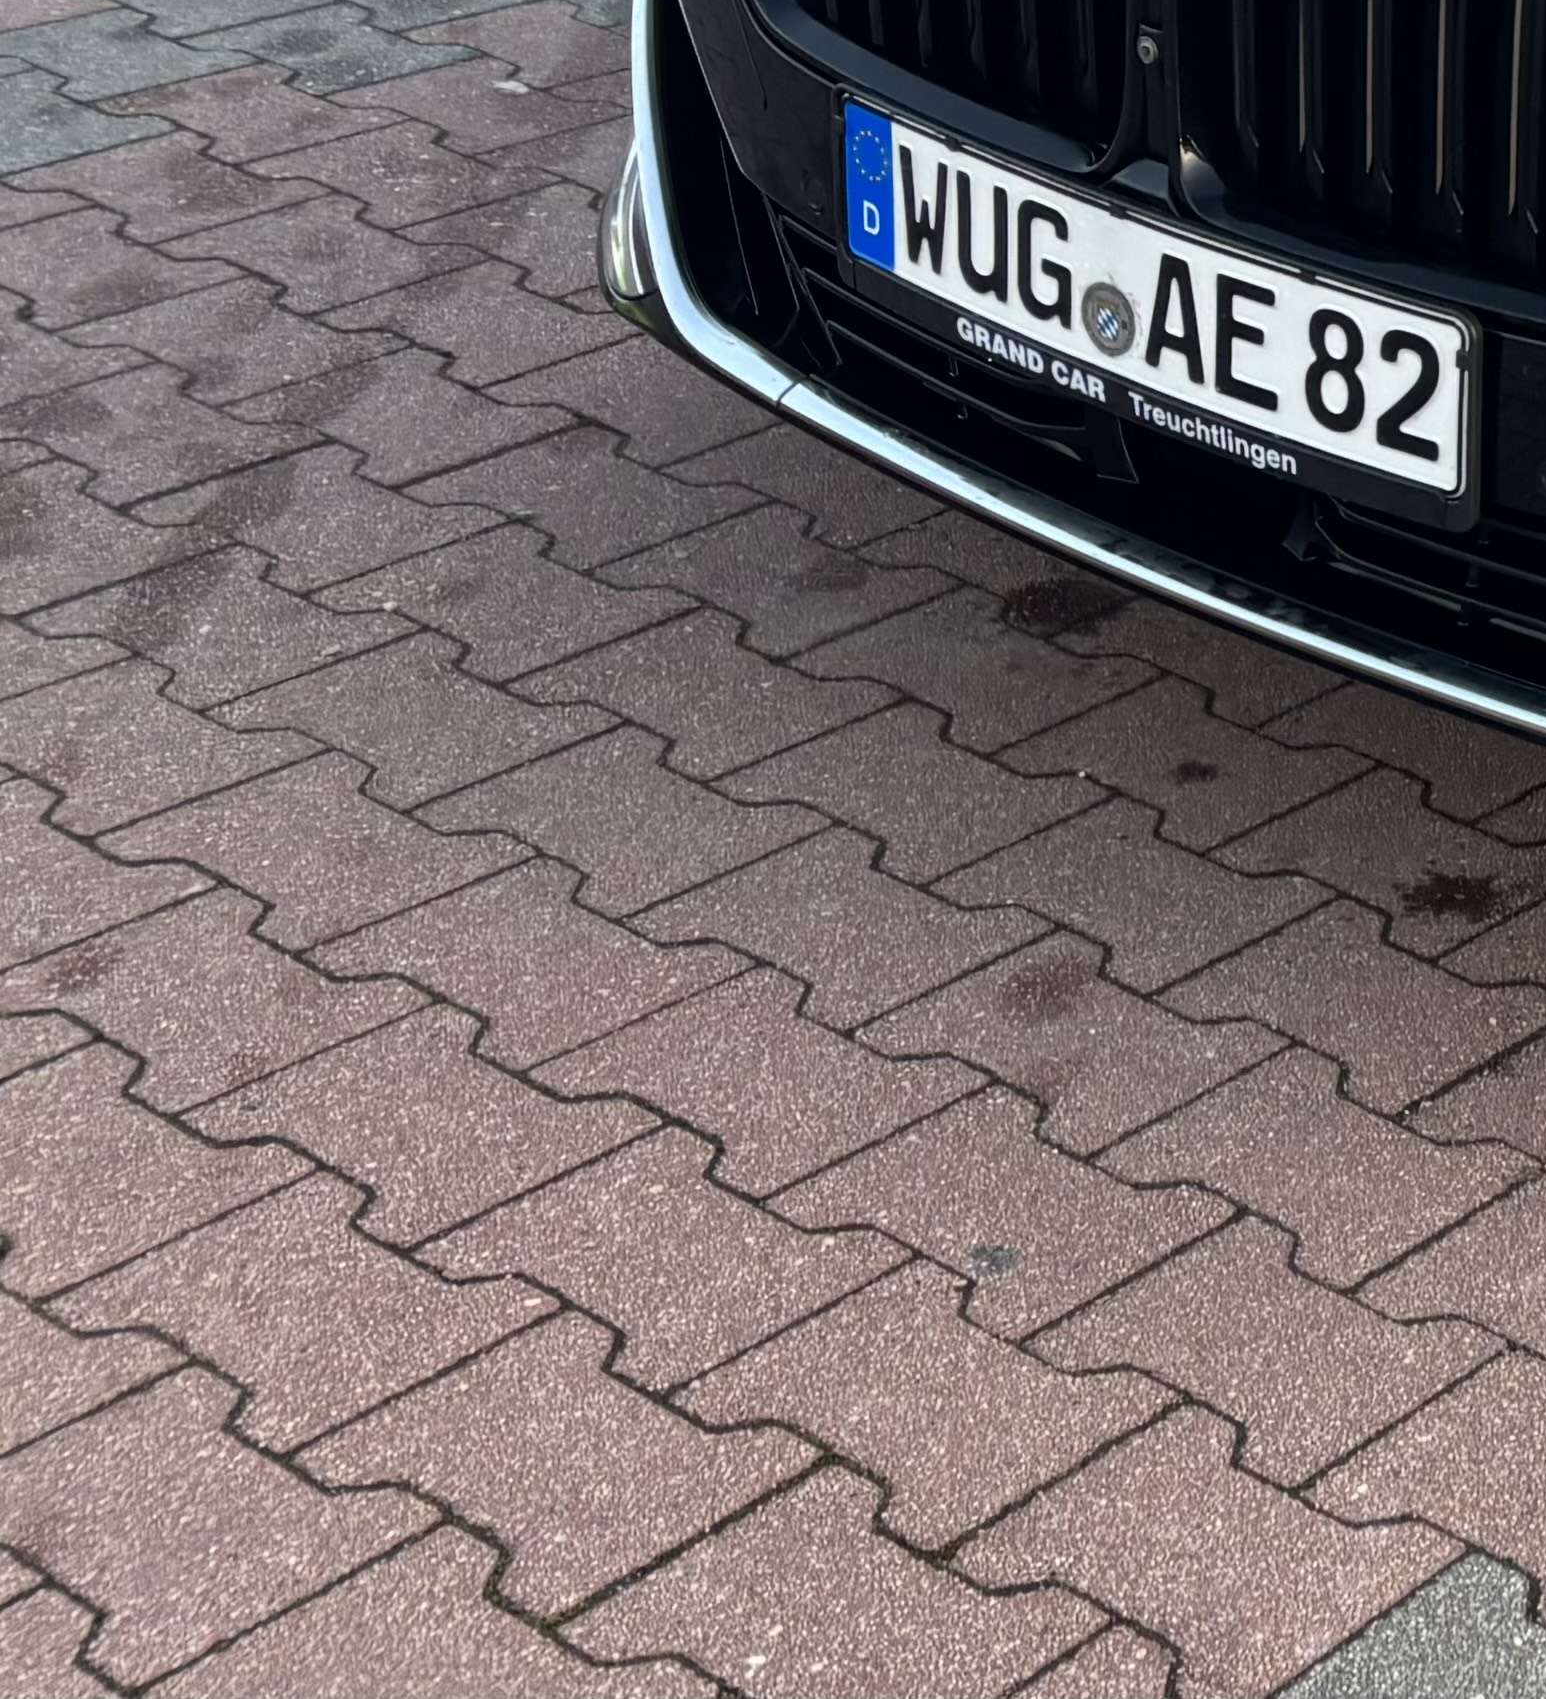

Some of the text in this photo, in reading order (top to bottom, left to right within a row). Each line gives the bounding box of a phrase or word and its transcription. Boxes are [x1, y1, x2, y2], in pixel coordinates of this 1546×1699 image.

[863, 200, 880, 236] D
[899, 144, 1440, 463] WUG AE 82
[957, 316, 1298, 476] GRAND CAR Treuchtlingen
